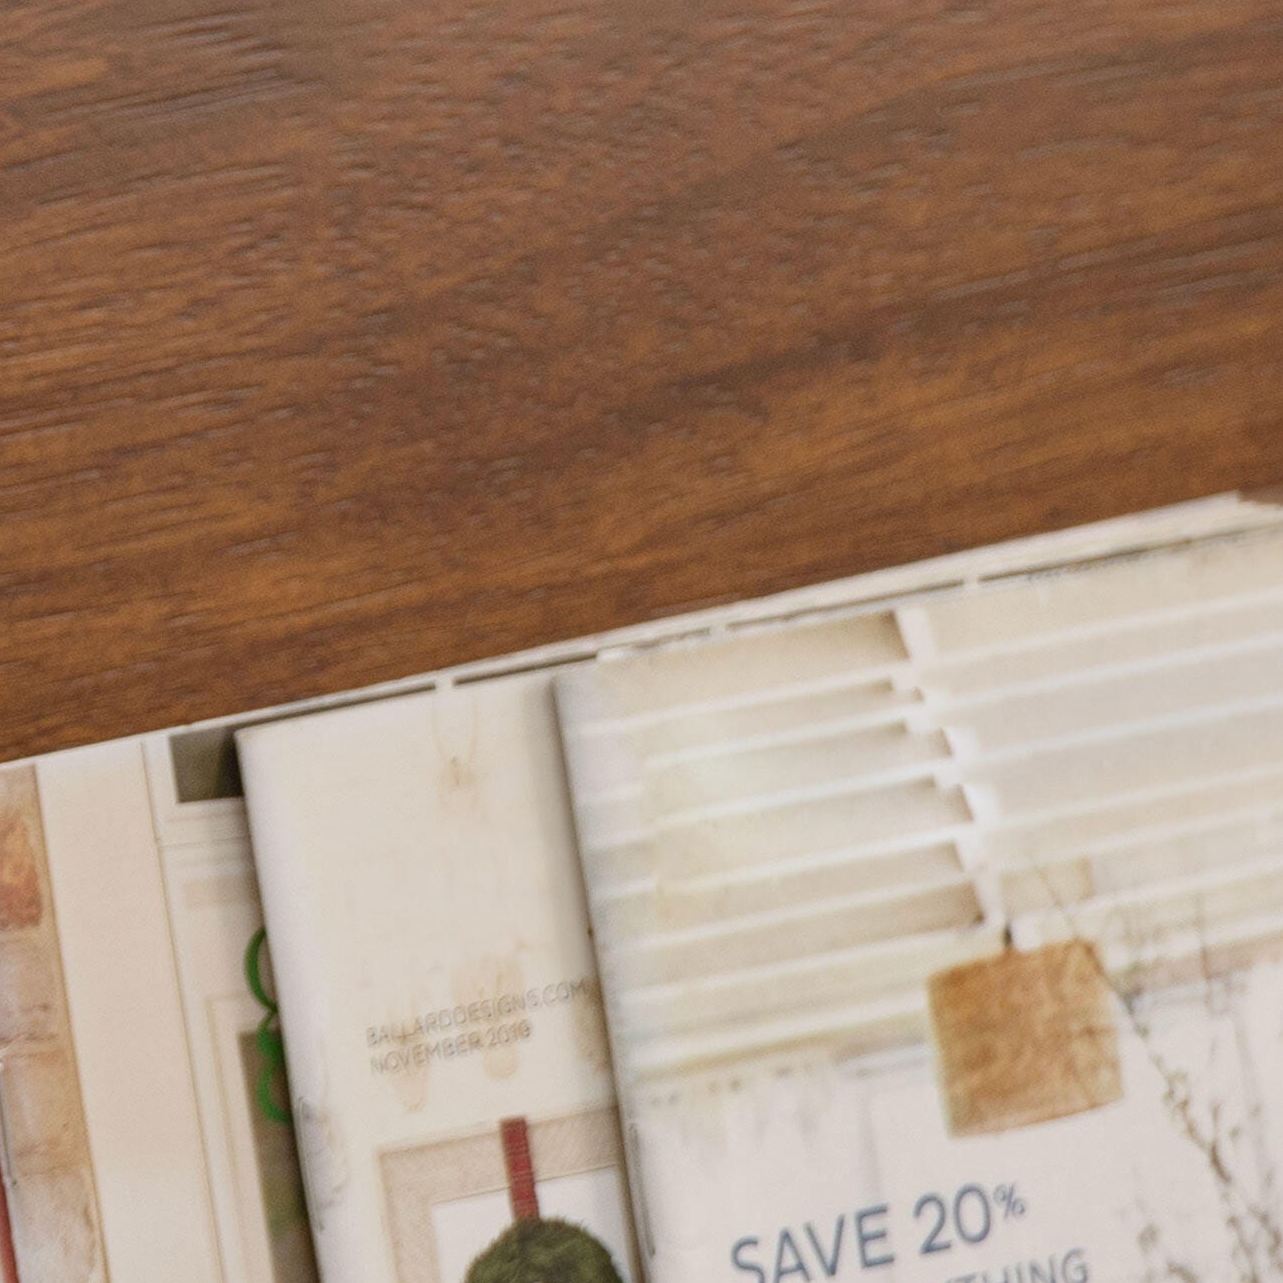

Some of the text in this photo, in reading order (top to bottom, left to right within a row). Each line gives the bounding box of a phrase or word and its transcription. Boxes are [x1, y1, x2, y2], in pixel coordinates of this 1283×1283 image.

[366, 978, 587, 1047] BALLARDDESIGNS.COM
[370, 1037, 486, 1074] NOVEMBER
[913, 1182, 1027, 1256] 20%
